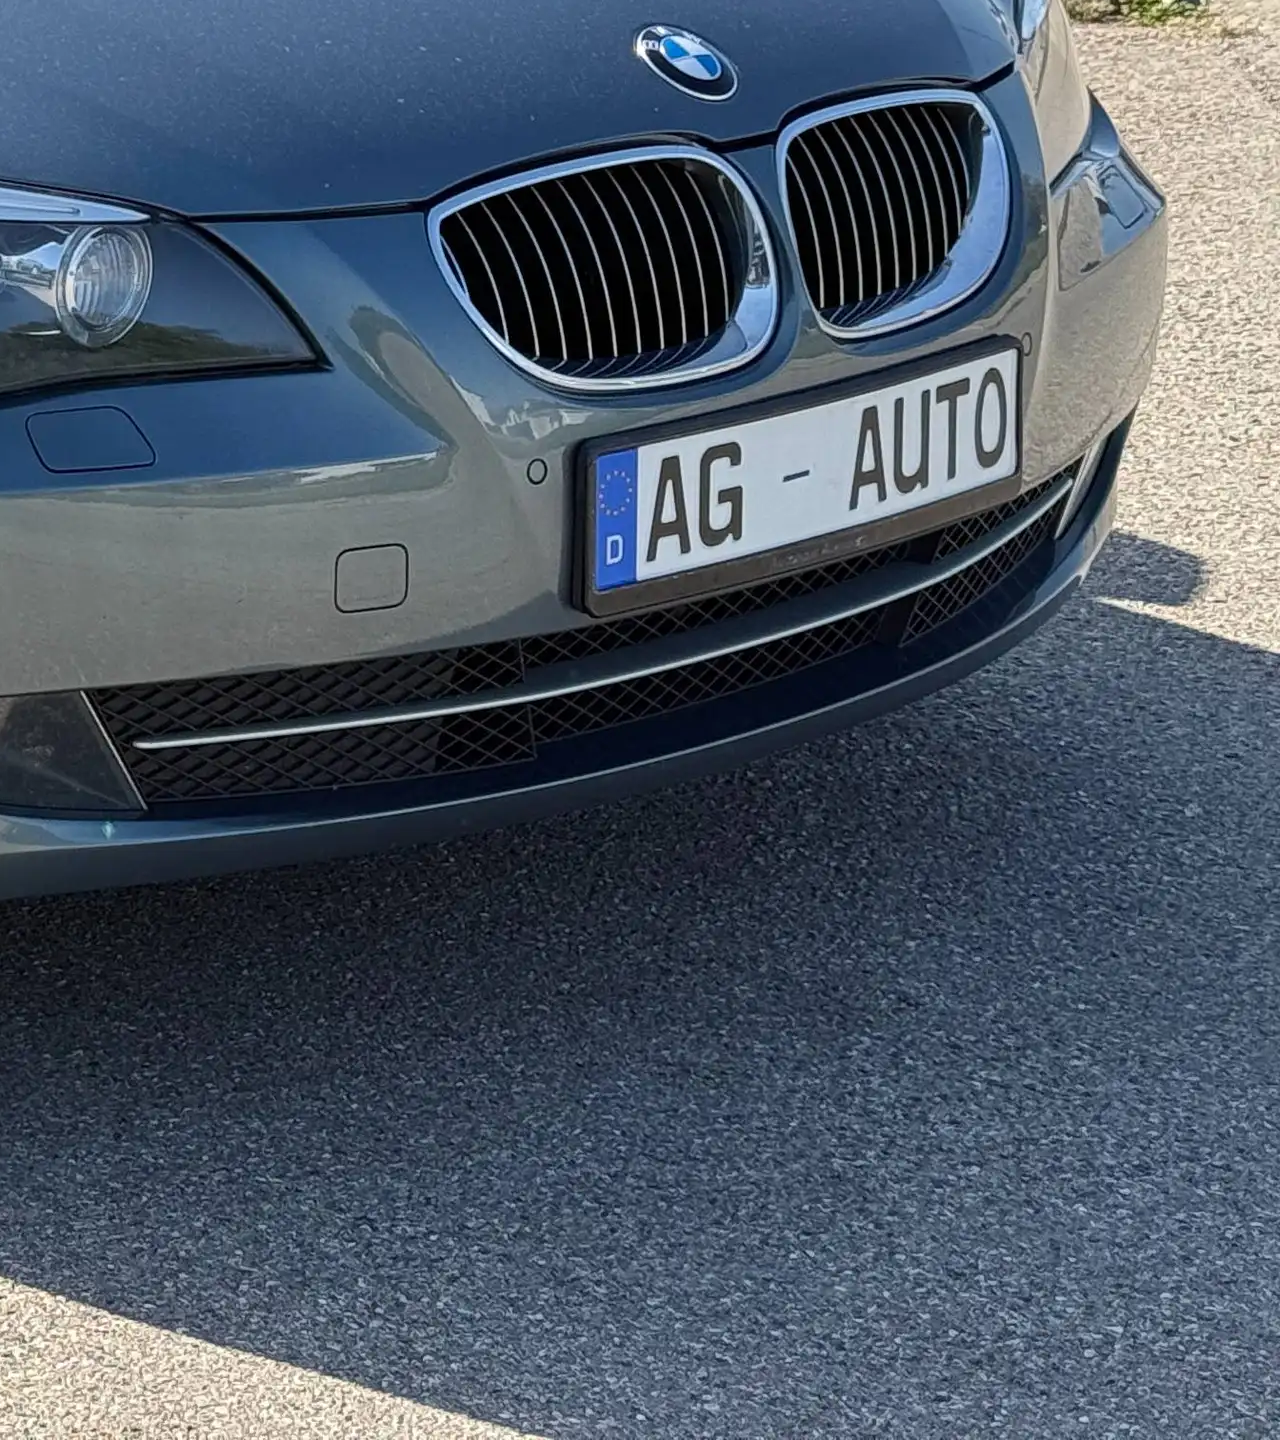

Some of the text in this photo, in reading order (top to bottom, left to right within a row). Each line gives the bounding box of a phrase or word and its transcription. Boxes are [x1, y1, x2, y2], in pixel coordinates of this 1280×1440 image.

[646, 441, 743, 563] AG
[849, 367, 1008, 511] AUTO
[605, 533, 624, 567] D
